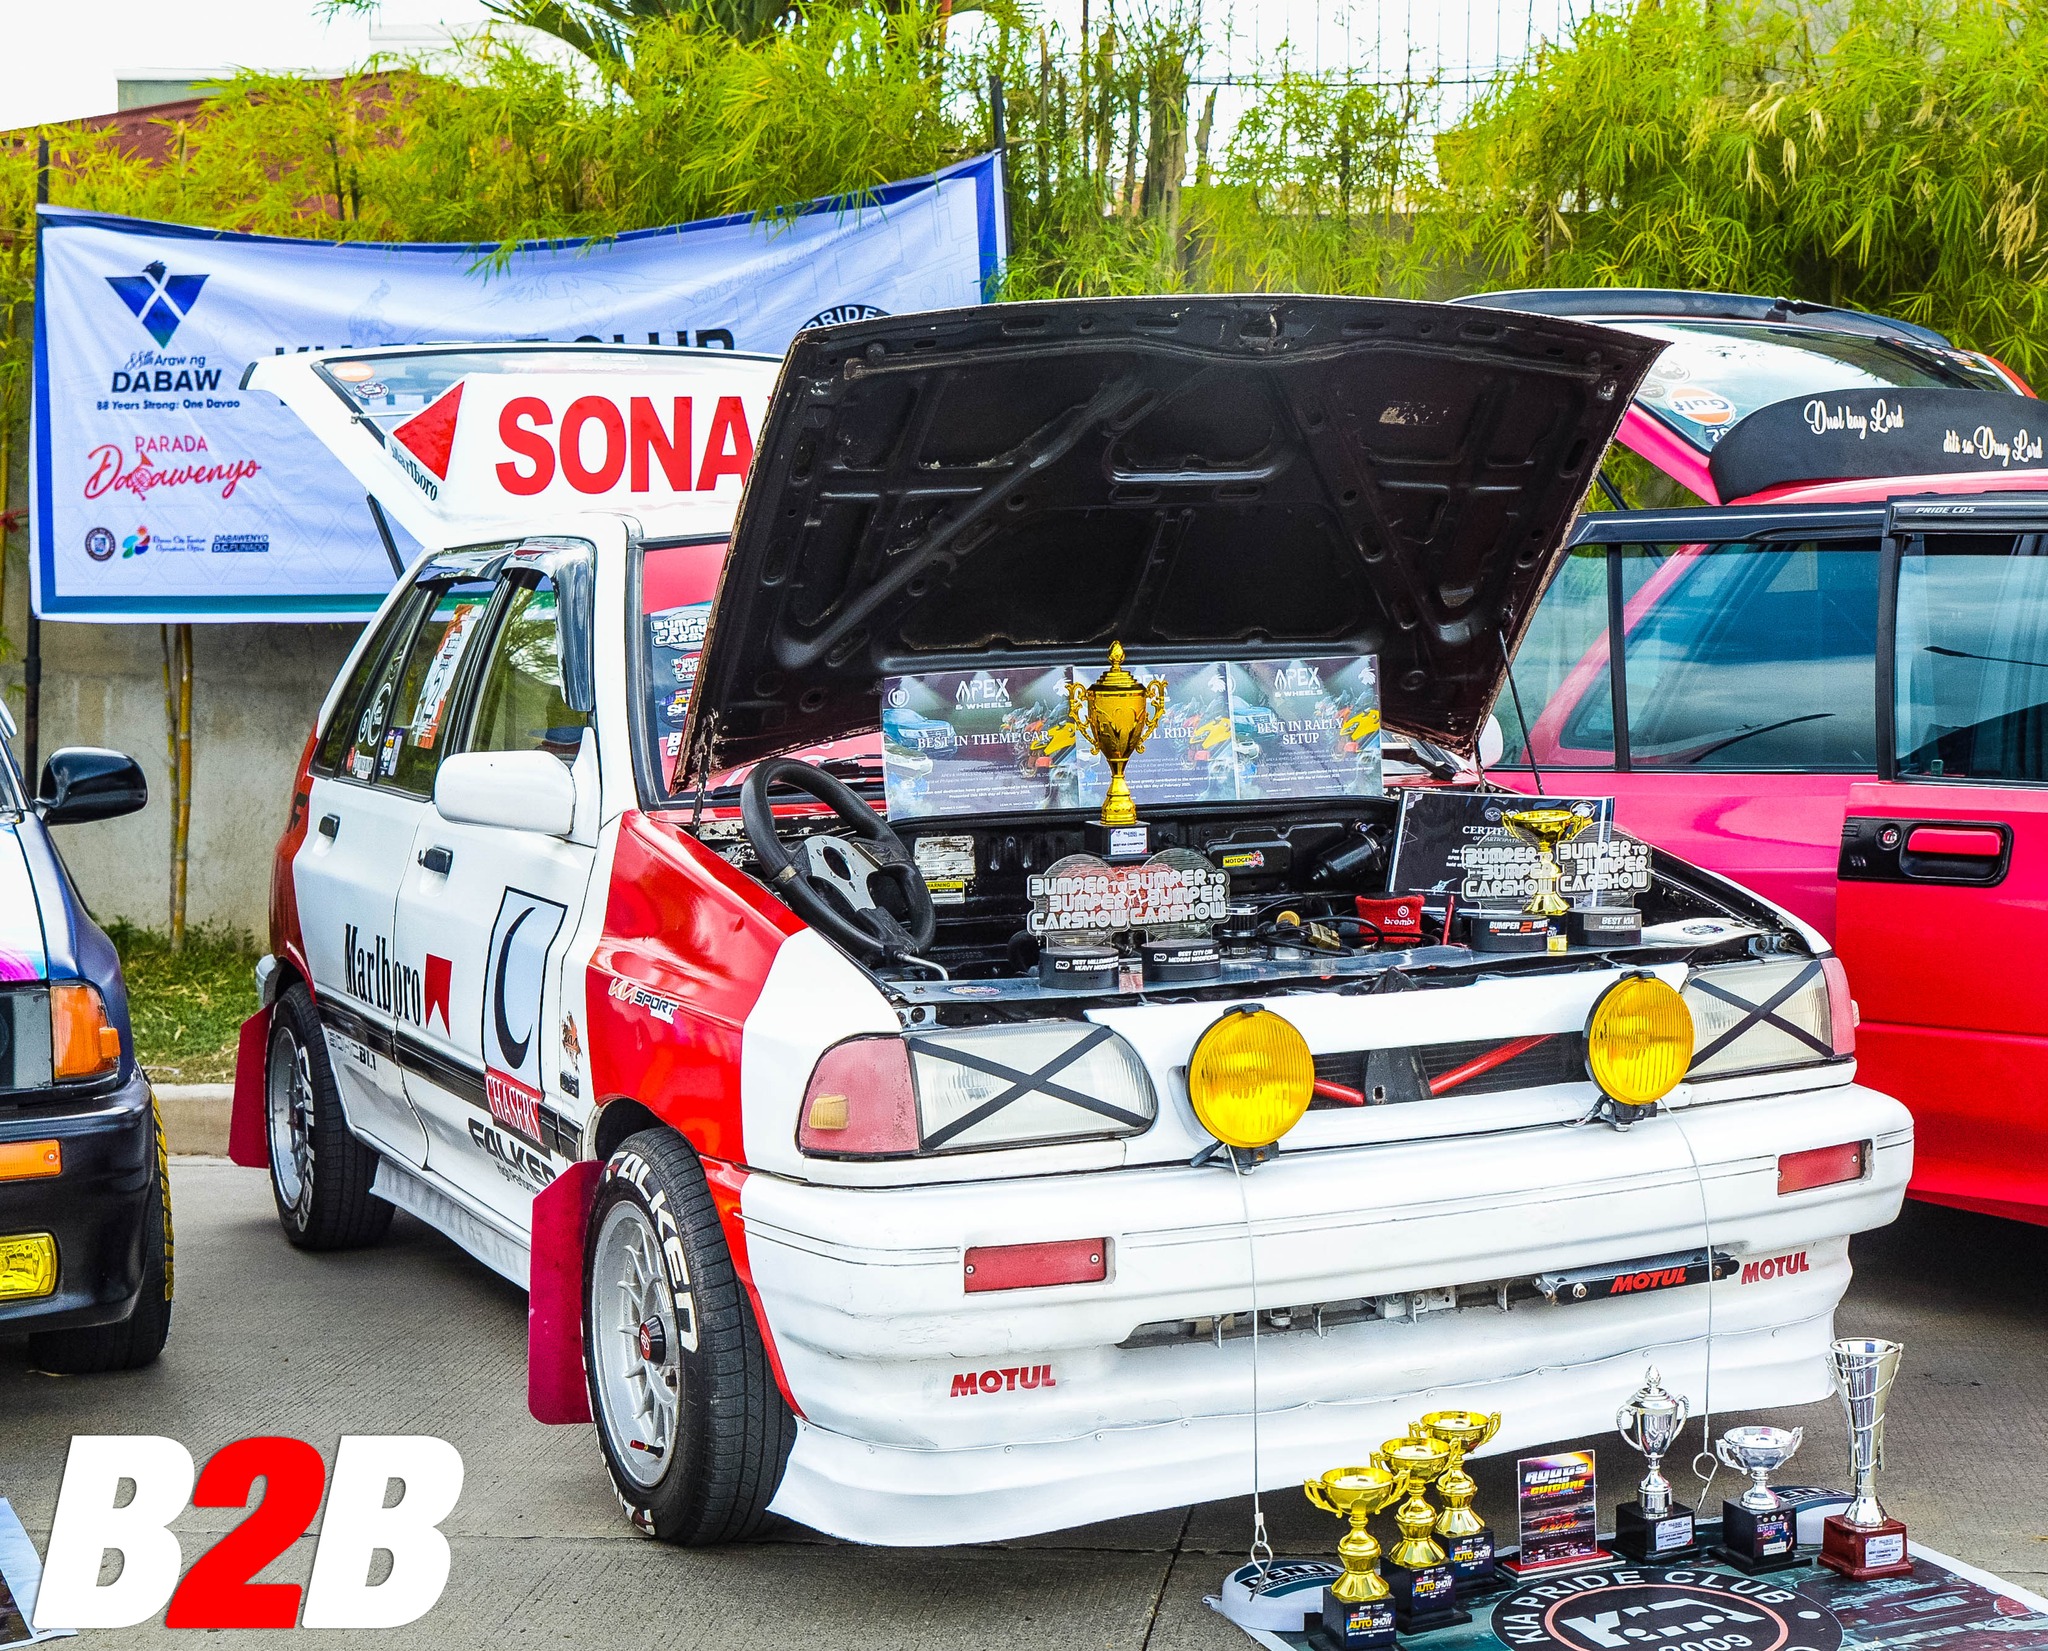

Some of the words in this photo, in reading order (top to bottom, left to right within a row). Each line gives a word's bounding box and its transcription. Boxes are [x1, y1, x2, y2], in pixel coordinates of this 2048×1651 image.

[154, 354, 186, 366] Araw
[189, 355, 206, 368] ng
[111, 368, 222, 393] DABAW
[112, 401, 139, 410] Years
[183, 399, 203, 409] One
[206, 399, 240, 409] Davao
[1673, 398, 1729, 411] Gulf
[1869, 398, 1905, 433] Lord
[135, 435, 208, 453] PARADA
[495, 395, 772, 496] SONA
[2012, 428, 2043, 463] Lord
[1914, 506, 1951, 514] PRIDE
[1274, 667, 1320, 691] APEX
[955, 678, 1010, 702] APEX
[1285, 689, 1323, 697] WHEELS
[966, 701, 1012, 709] WHEELS
[1164, 726, 1195, 739] RIDE
[1257, 721, 1285, 734] BEST
[1289, 720, 1301, 732] IN
[1302, 718, 1344, 731] RALLY
[918, 736, 949, 750] BEST
[954, 735, 967, 747] IN
[971, 732, 1020, 746] THEME
[1023, 730, 1051, 742] CAR
[1283, 732, 1320, 745] SETUP
[1465, 846, 1538, 864] BUMPER
[1560, 841, 1632, 860] BUMPER
[1633, 845, 1648, 855] TO
[1481, 862, 1553, 881] BUMPER
[1576, 856, 1647, 875] BUMPER
[1031, 875, 1107, 897] BUMPER
[1127, 869, 1206, 887] BUMPER
[1207, 872, 1225, 885] TO
[1561, 871, 1648, 892] CARSHOW
[1147, 885, 1225, 907] BUMPER
[1465, 879, 1552, 898] CARSHOW
[1049, 895, 1129, 913] BUMPER
[1031, 910, 1129, 931] CARSHOW
[1129, 902, 1226, 926] CARSHOW
[1601, 916, 1623, 925] BEST
[1489, 921, 1520, 930] BUMPER
[345, 923, 422, 1027] Marlboro
[635, 990, 678, 1016] SPORT
[484, 1075, 543, 1142] CHASERS
[605, 1151, 699, 1354] FALKEN
[1741, 1251, 1810, 1285] MOTUL
[1610, 1267, 1687, 1294] MOTUL
[949, 1364, 1057, 1398] MOTUL
[1453, 1552, 1474, 1561] AUTO
[1473, 1549, 1492, 1559] SHOW
[1414, 1582, 1435, 1593] AUTO
[1435, 1579, 1453, 1589] SHOW
[1523, 1570, 1646, 1609] PRIDE
[1663, 1571, 1797, 1604] CLUB
[1348, 1619, 1373, 1630] AUTO
[1373, 1616, 1393, 1627] SHOW
[1502, 1612, 1551, 1645] KIA
